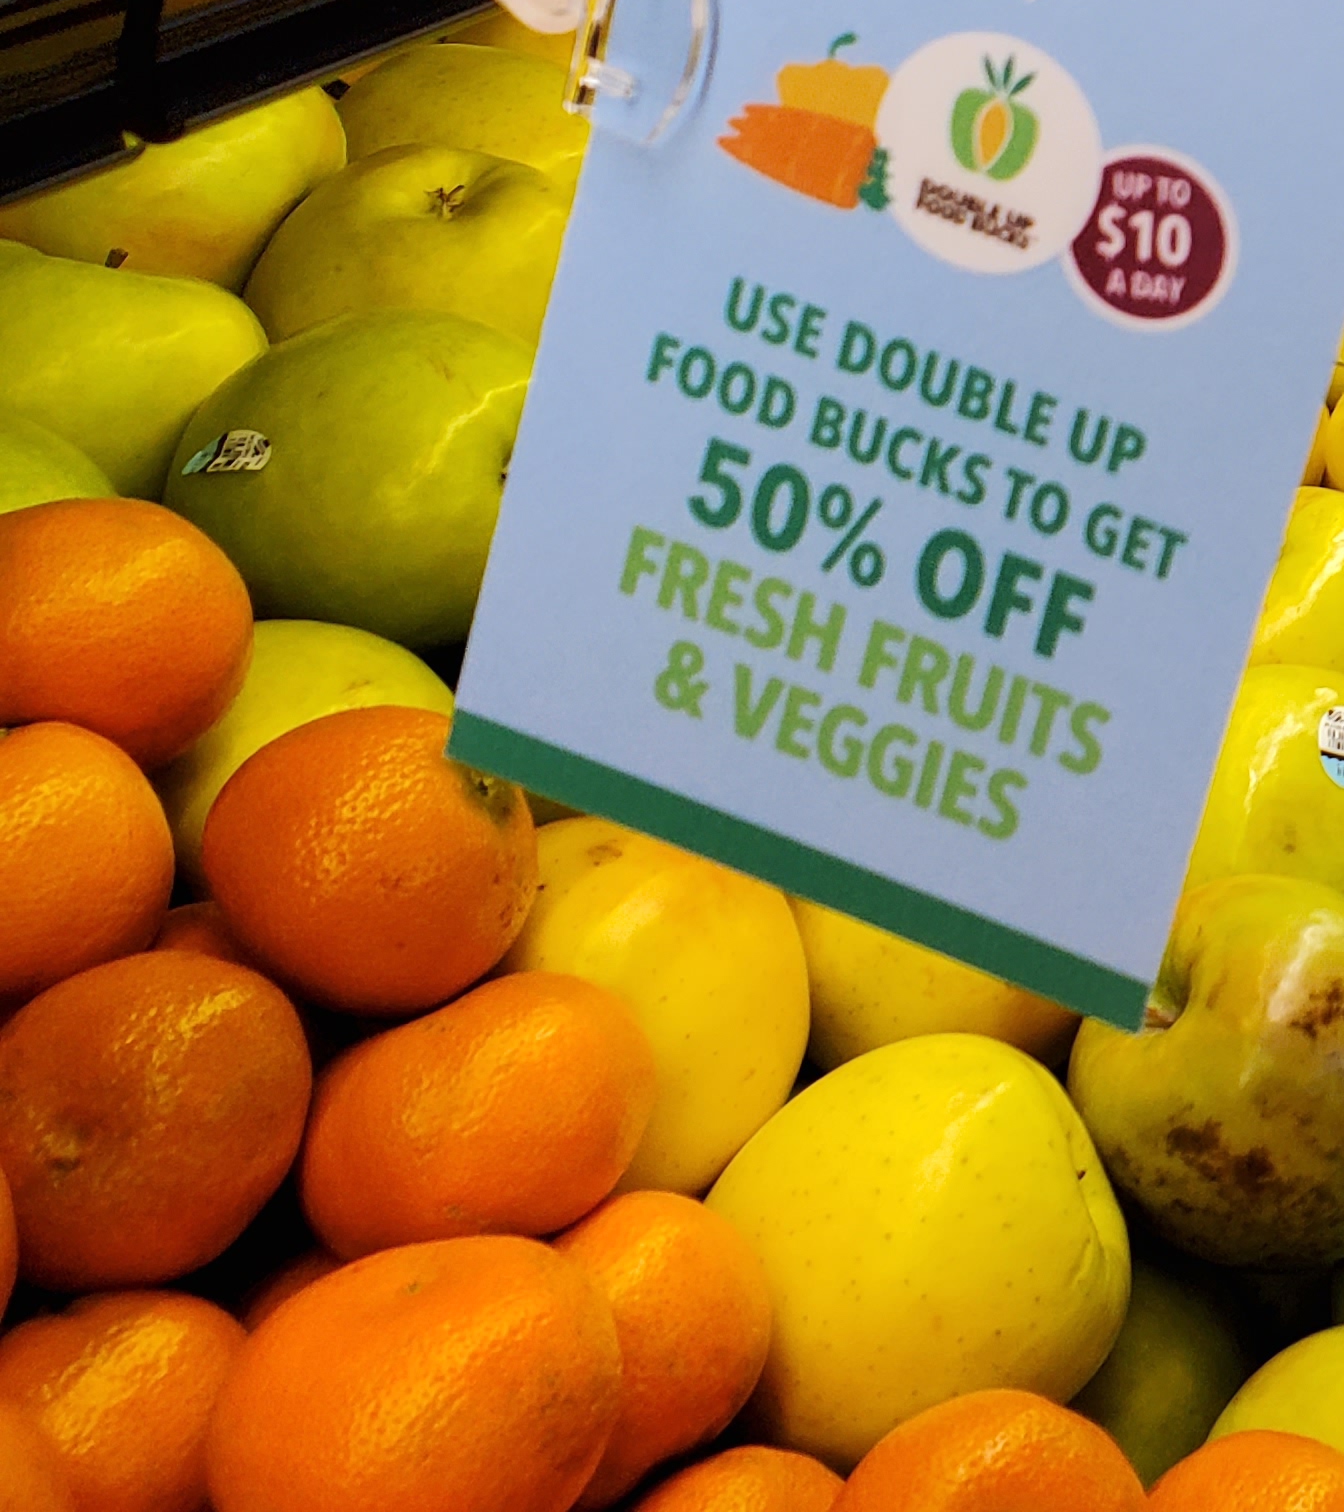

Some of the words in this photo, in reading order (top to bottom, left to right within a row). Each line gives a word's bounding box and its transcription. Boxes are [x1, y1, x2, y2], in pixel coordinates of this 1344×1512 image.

[1095, 207, 1193, 269] $10
[1105, 269, 1126, 297] A
[1130, 272, 1187, 305] DAY
[1110, 170, 1151, 202] UP
[1152, 176, 1193, 208] TO
[646, 331, 797, 430] FOOD
[809, 395, 993, 506] BUCKS
[1004, 466, 1069, 535] TO
[1083, 503, 1189, 580] GET
[723, 276, 828, 359] USE
[836, 320, 1059, 448] DOUBLE
[1068, 407, 1146, 474] UP
[687, 436, 885, 588] 50%
[915, 527, 1096, 658] OFF
[619, 524, 849, 673] FRESH
[857, 618, 1111, 777] FRUITS
[653, 640, 710, 719] &
[731, 662, 1030, 841] VEGGIES
